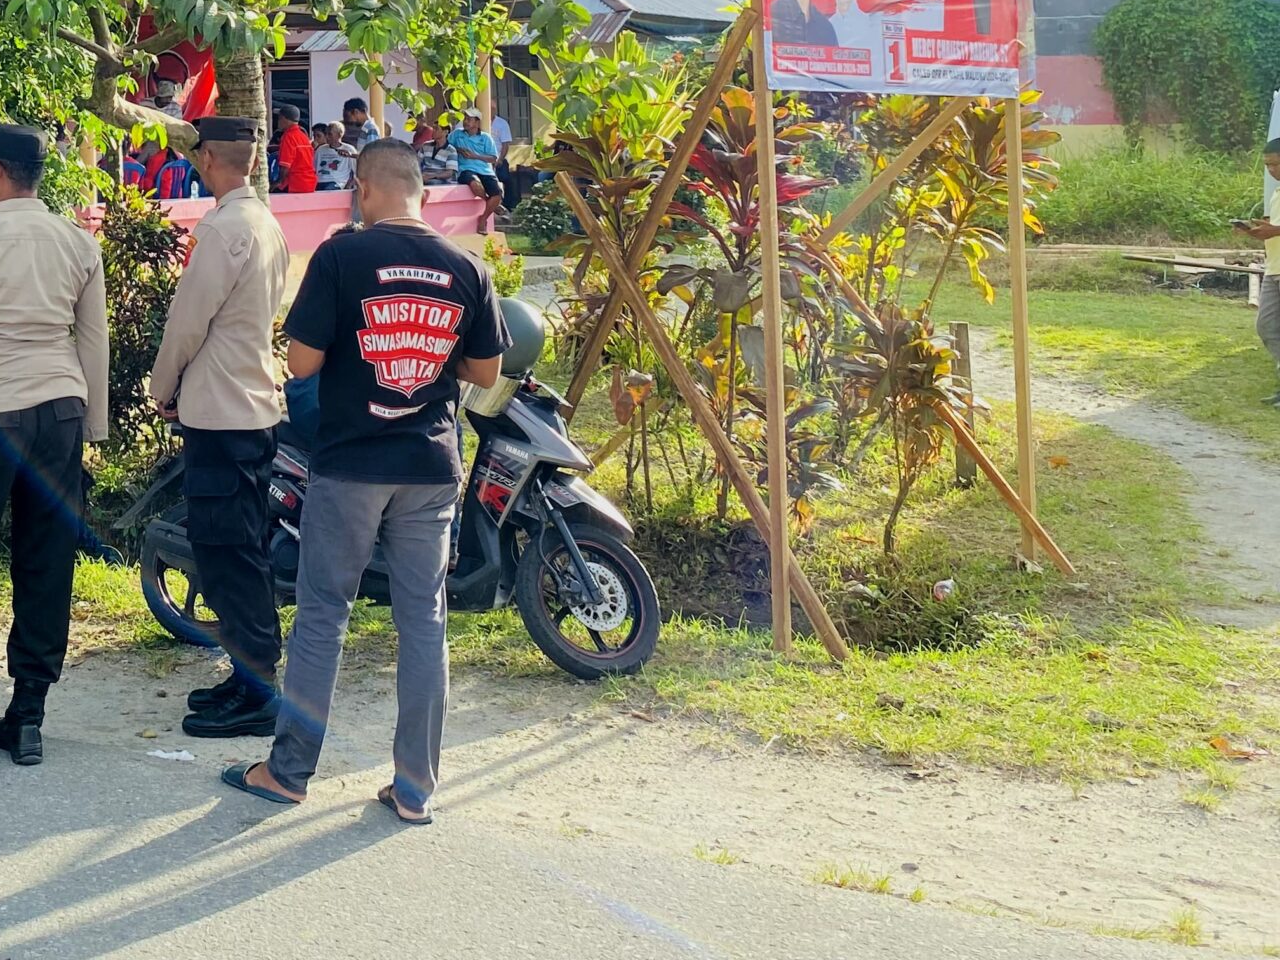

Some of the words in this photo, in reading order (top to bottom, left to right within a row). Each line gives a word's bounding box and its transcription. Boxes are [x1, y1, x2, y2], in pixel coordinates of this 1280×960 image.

[888, 41, 905, 81] 1
[386, 269, 442, 282] YAKARIMA
[372, 302, 452, 329] MUSITOA
[505, 444, 529, 460] YAMAHA
